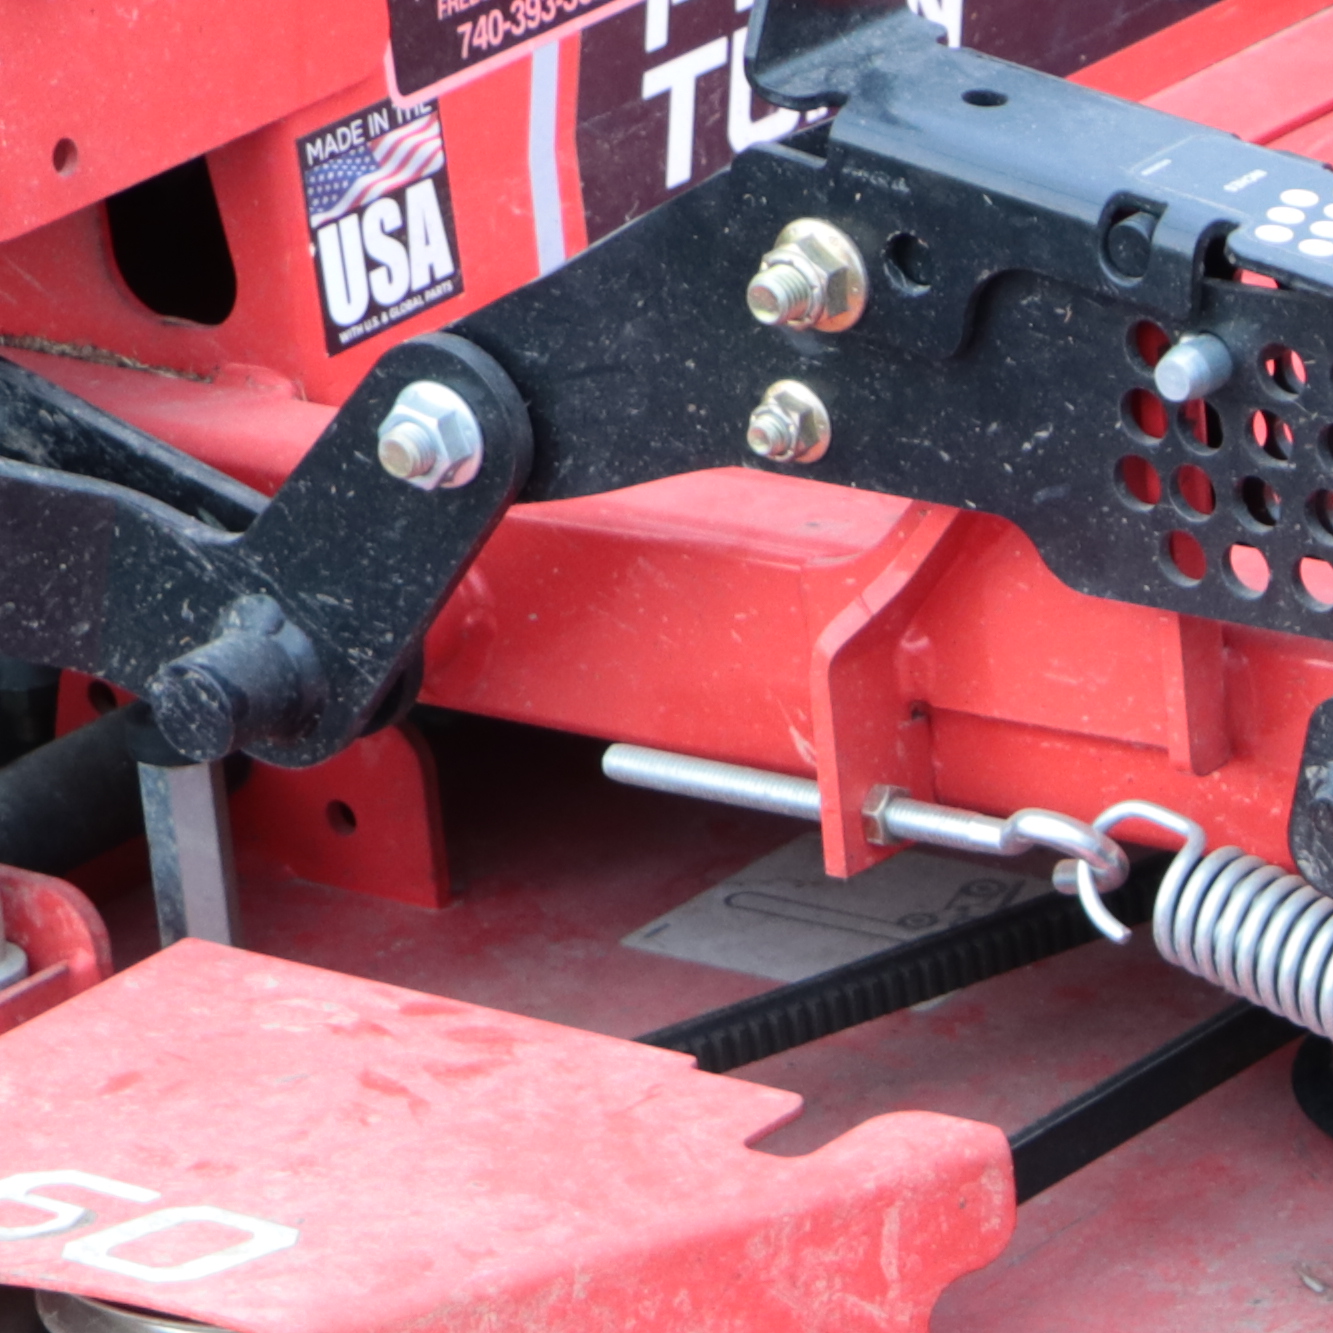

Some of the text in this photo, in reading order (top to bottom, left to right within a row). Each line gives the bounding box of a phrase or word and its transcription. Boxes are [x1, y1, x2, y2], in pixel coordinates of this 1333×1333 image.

[457, 0, 593, 59] 740-393-
[305, 118, 366, 167] MADE
[367, 107, 390, 138] IN
[317, 178, 455, 327] USA
[424, 279, 454, 303] PARTS
